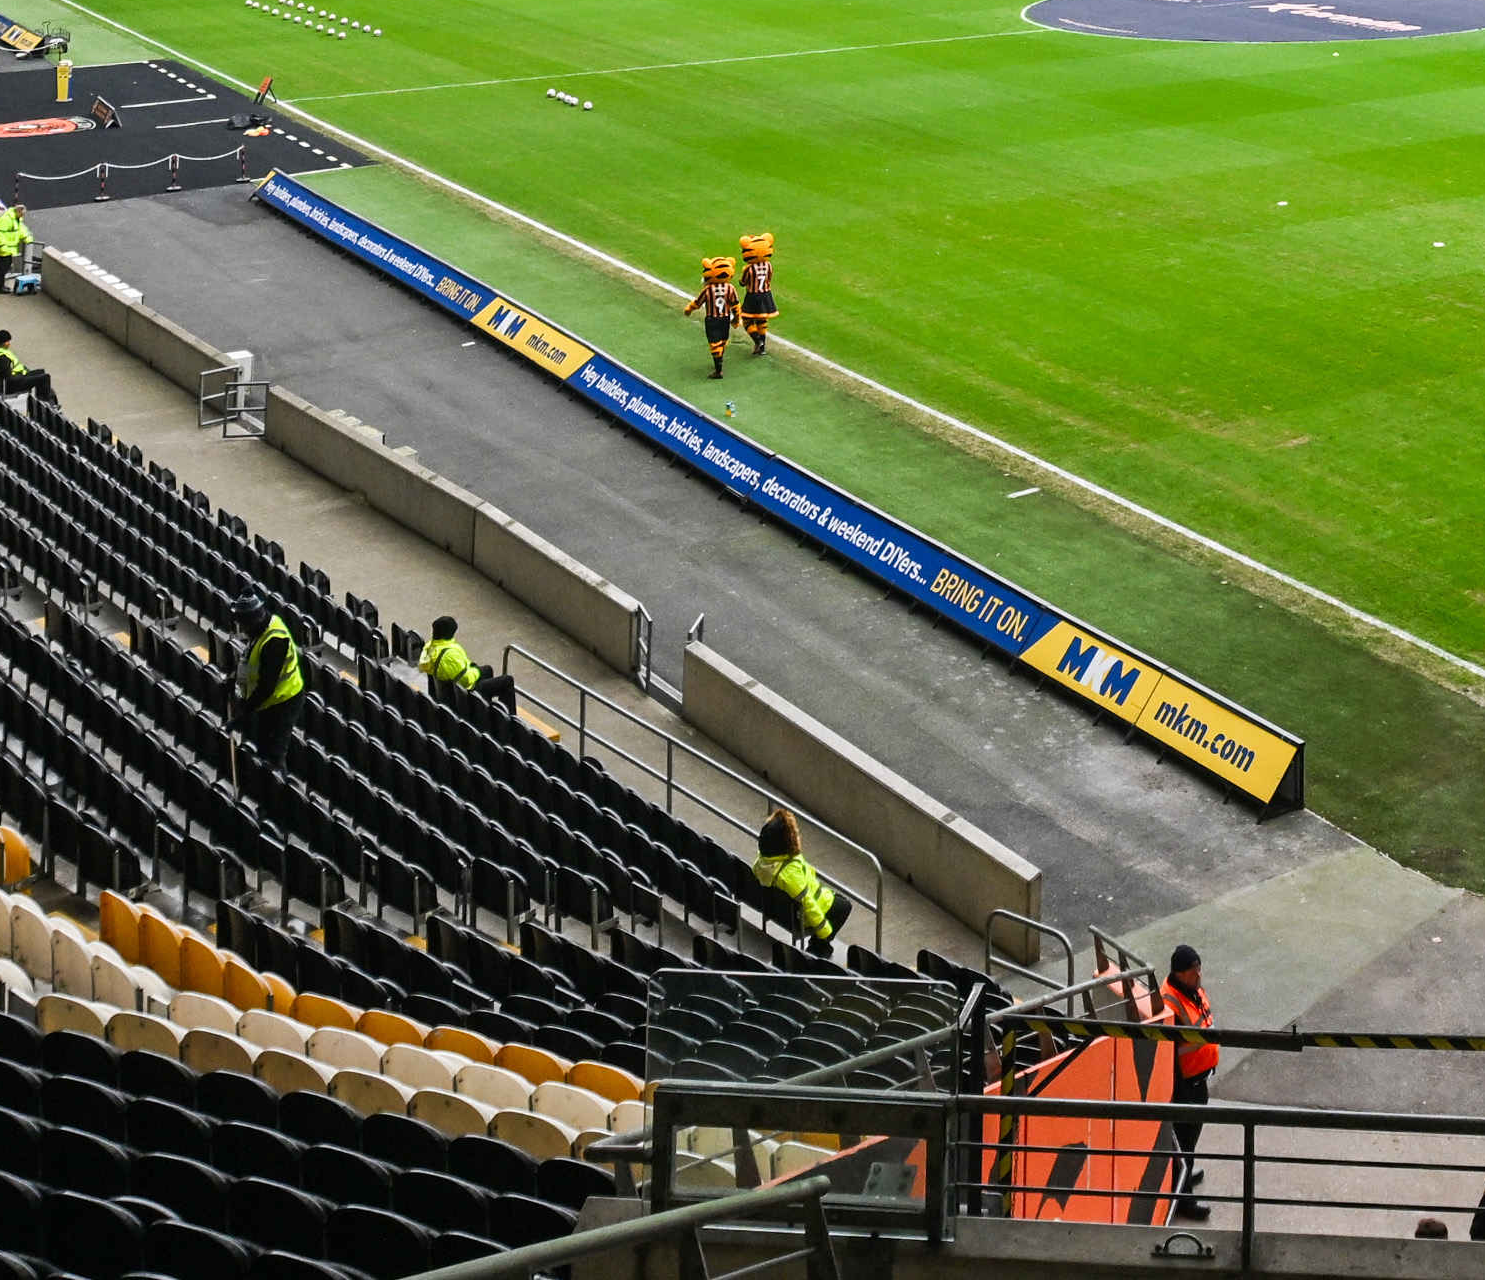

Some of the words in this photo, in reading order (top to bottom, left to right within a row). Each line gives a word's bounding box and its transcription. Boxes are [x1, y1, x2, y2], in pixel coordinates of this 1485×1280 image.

[435, 276, 459, 299] BRING
[459, 288, 471, 305] IT
[757, 275, 766, 292] 7
[715, 296, 725, 315] 9
[526, 334, 567, 365] mkm.com
[580, 363, 596, 387] Hey
[596, 377, 627, 404] builders,
[627, 396, 667, 431] plumbers,
[667, 417, 703, 455] brickies,
[702, 440, 761, 490] landscapers,
[762, 476, 820, 520] decorators
[817, 507, 832, 527] &
[827, 514, 885, 557] weekend
[880, 540, 927, 585] DIYers...
[930, 568, 984, 614] BRING
[978, 596, 1003, 623] IT
[996, 606, 1030, 642] ON.
